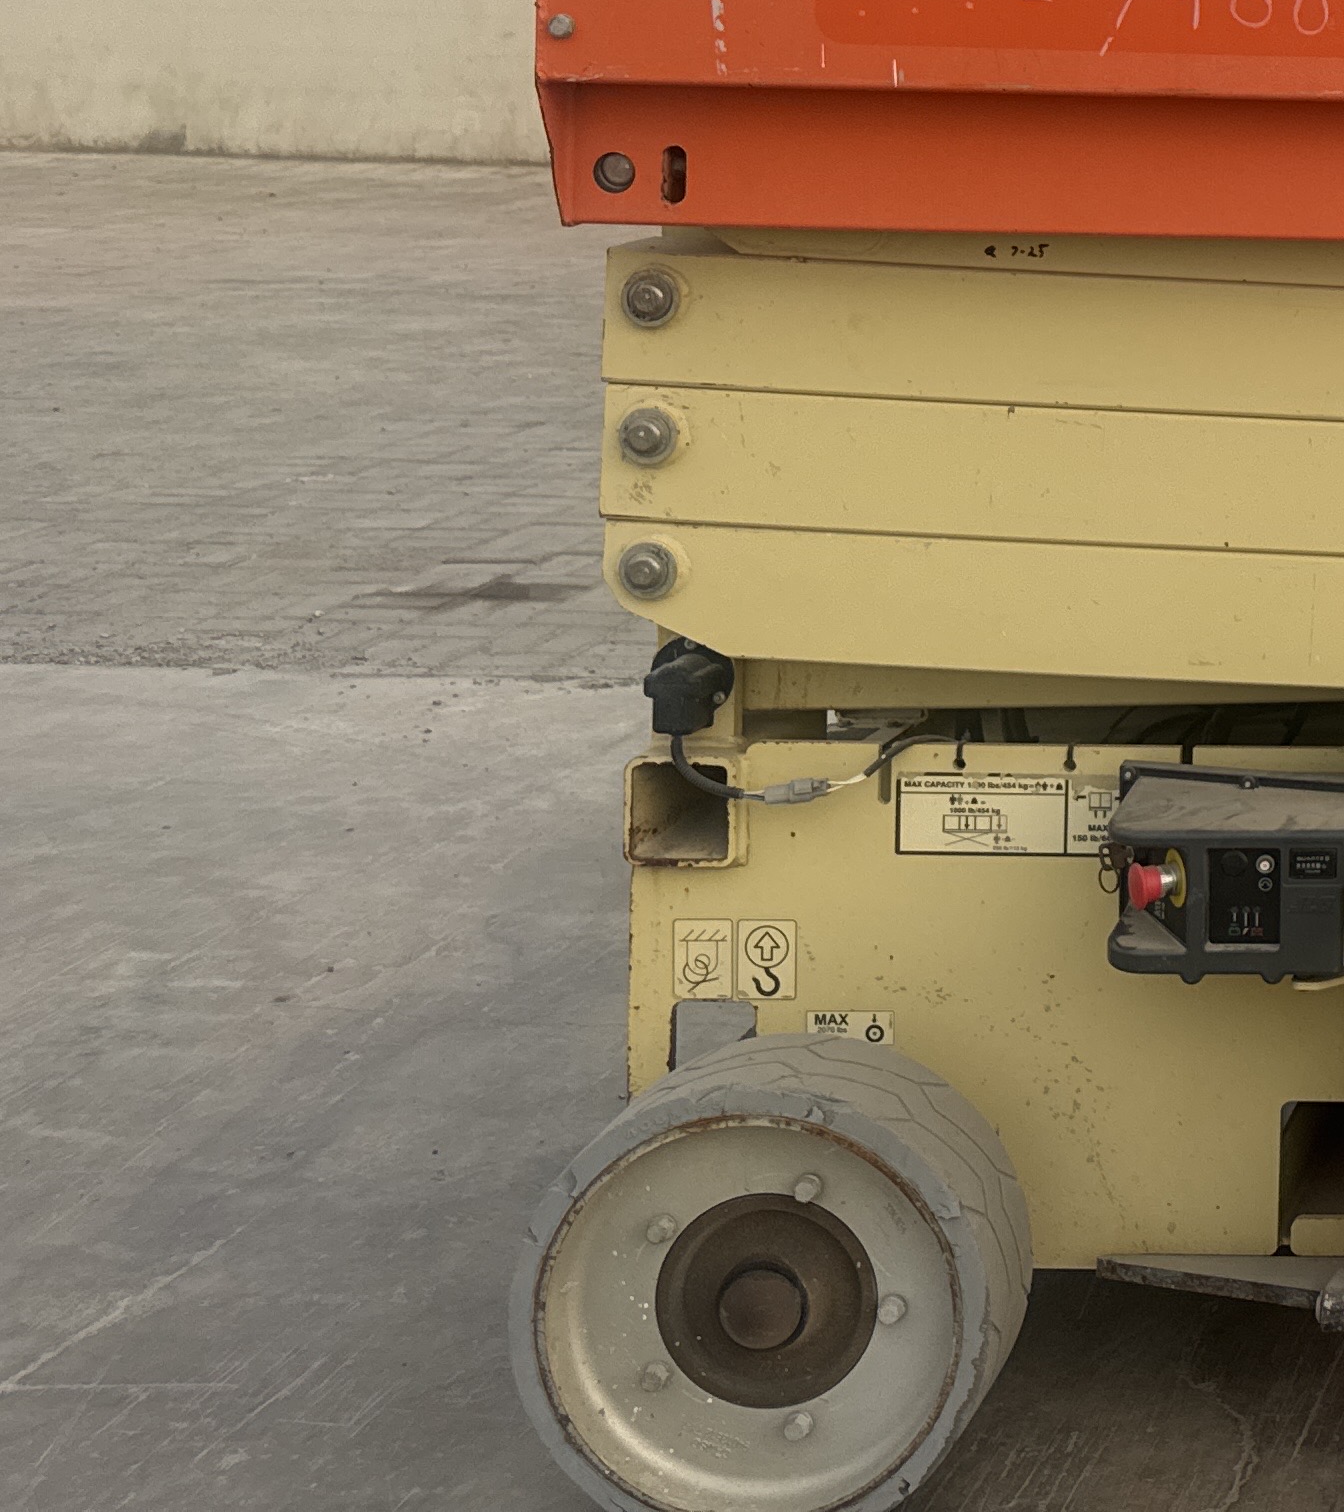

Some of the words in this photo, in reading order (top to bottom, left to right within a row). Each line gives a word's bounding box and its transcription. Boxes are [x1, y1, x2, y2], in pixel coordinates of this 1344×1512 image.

[904, 780, 922, 788] MAX
[924, 780, 965, 788] CAPACITY
[1087, 823, 1110, 832] MAX
[814, 1013, 849, 1026] MAX
